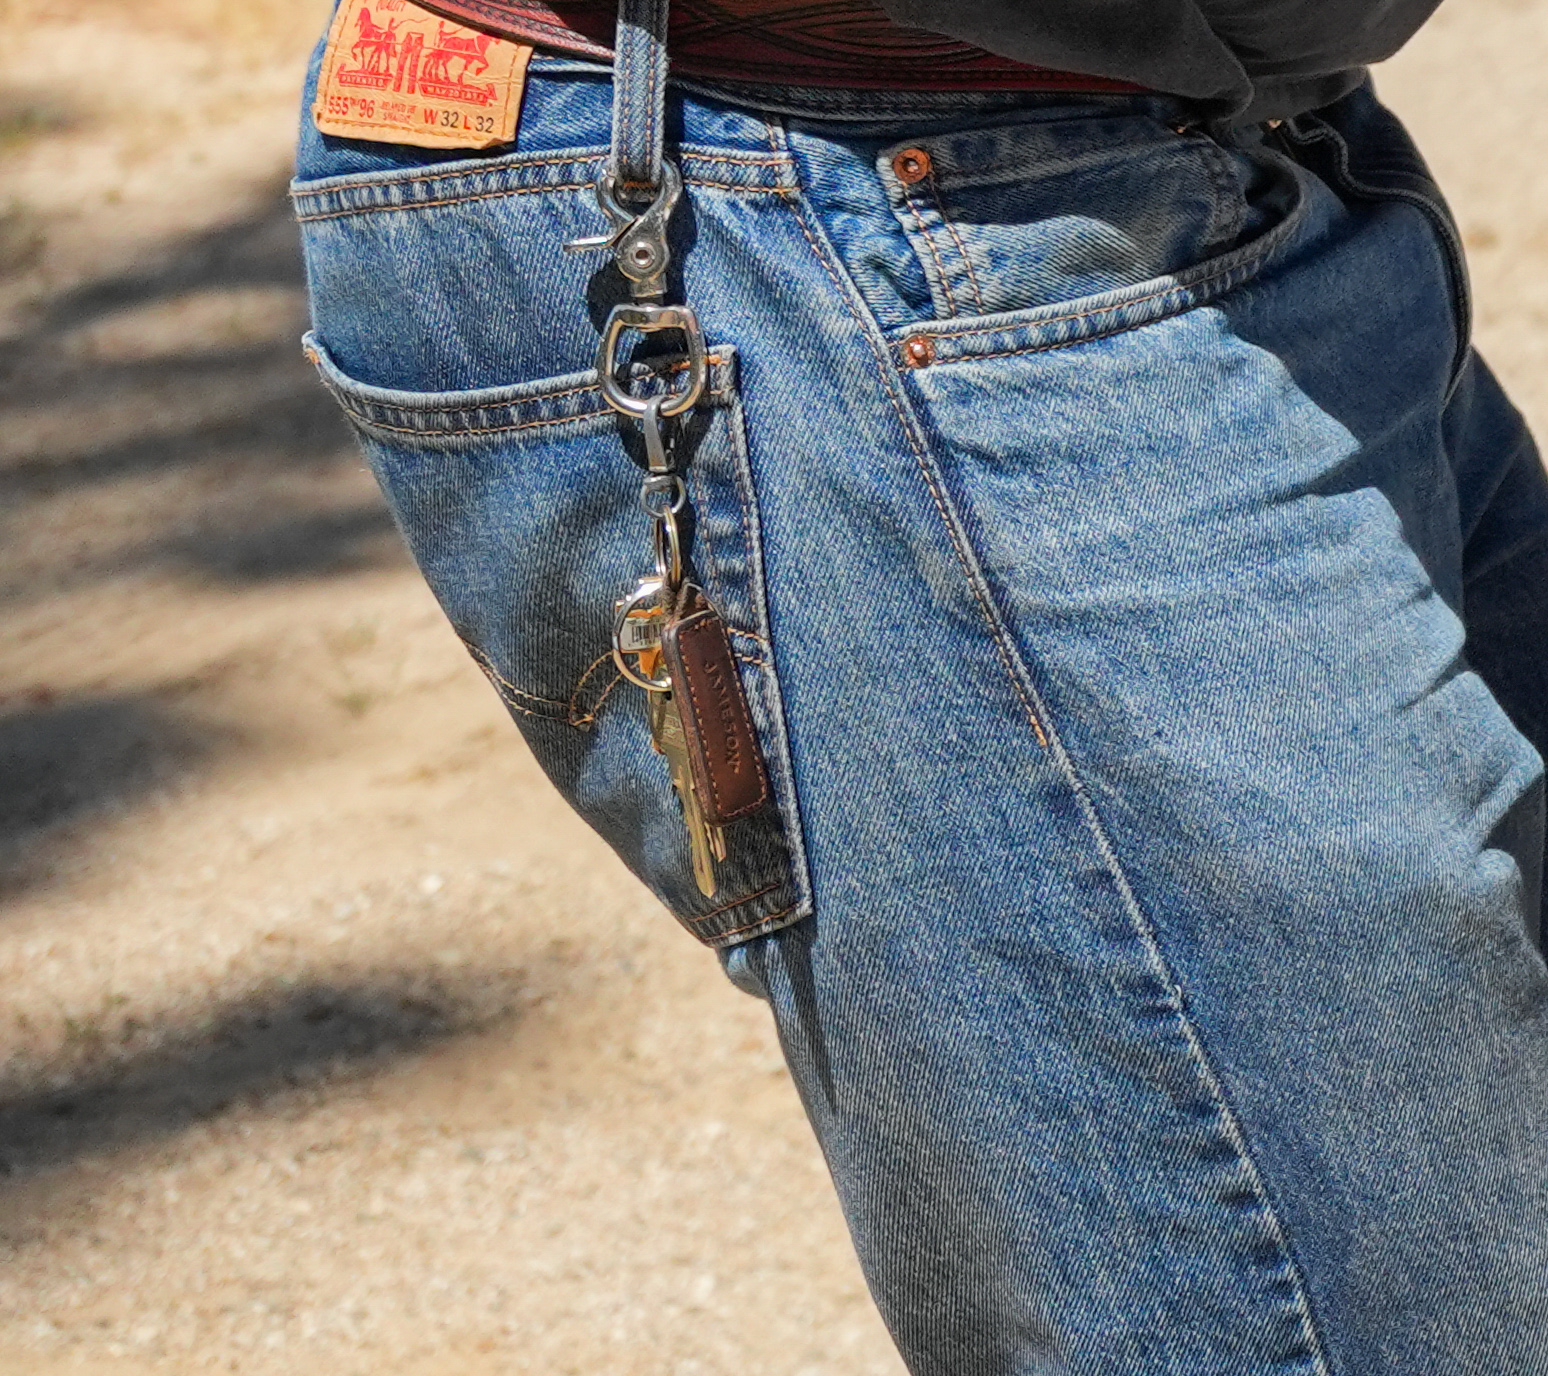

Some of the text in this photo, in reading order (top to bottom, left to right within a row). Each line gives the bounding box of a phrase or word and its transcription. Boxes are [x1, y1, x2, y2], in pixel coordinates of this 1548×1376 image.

[423, 108, 438, 125] W
[440, 110, 459, 129] 32
[463, 114, 471, 130] L
[475, 115, 495, 134] 32
